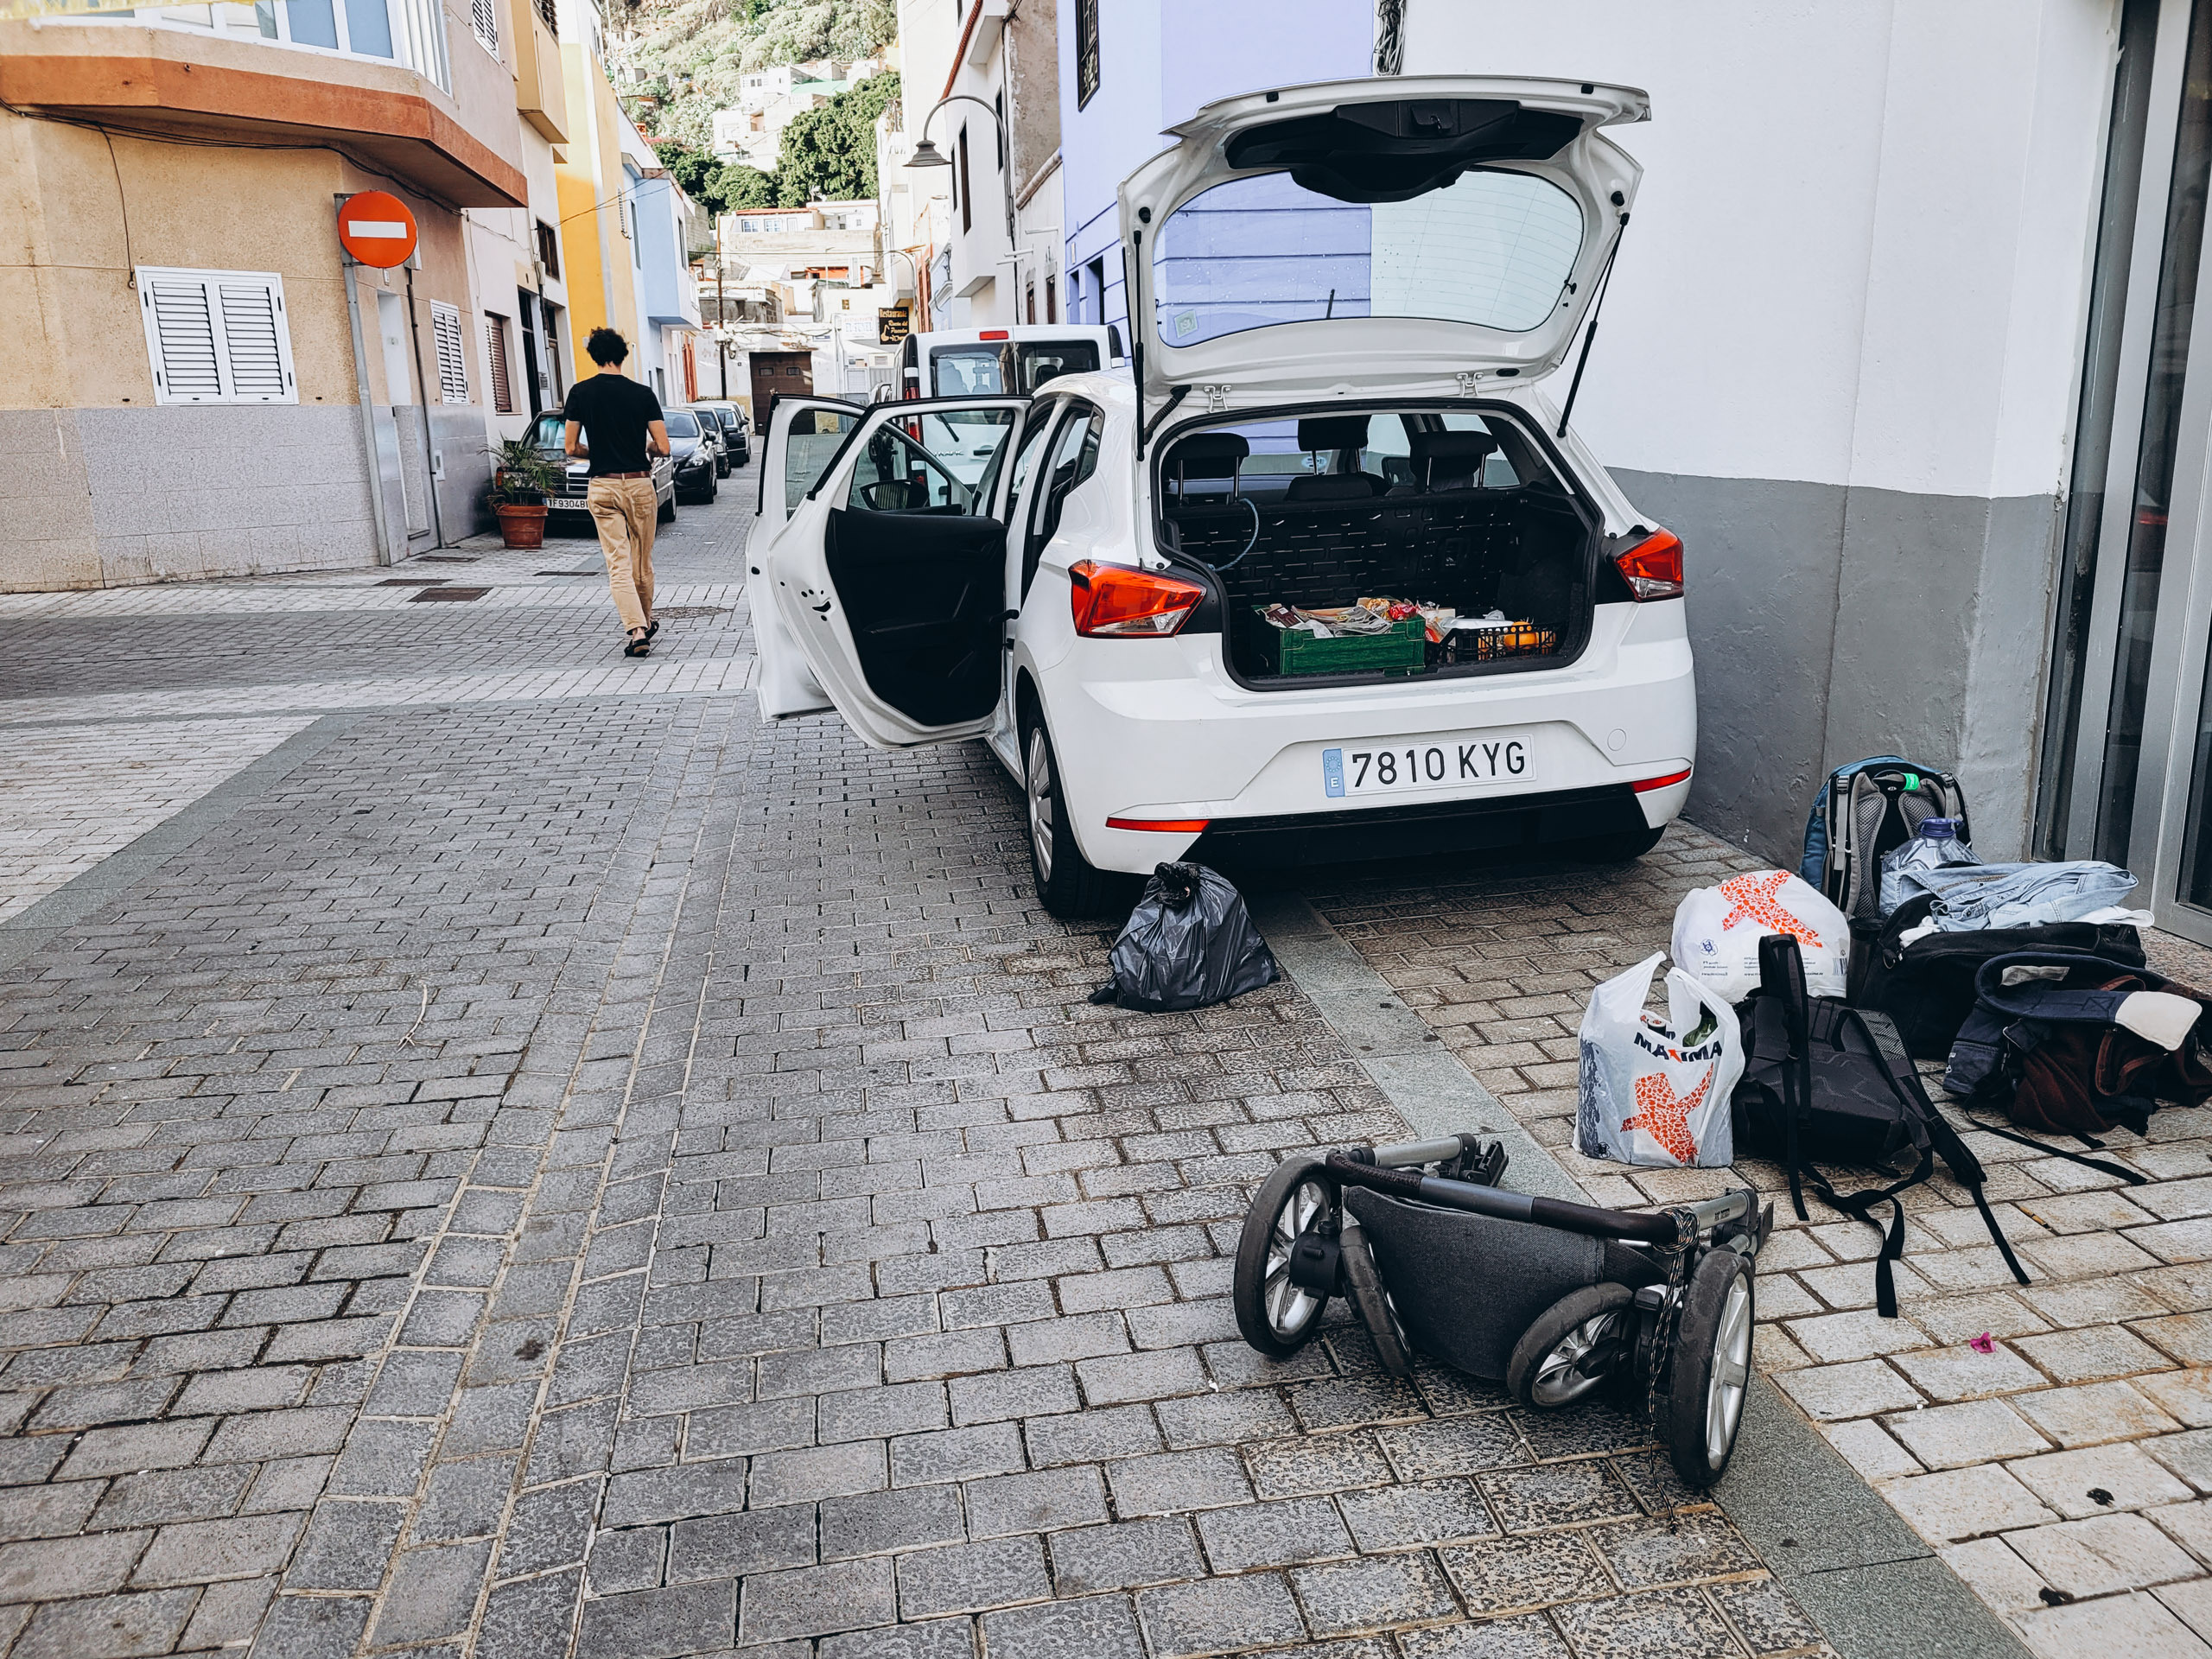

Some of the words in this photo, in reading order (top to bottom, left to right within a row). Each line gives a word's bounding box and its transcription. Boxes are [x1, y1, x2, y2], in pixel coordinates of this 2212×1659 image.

[1351, 747, 1446, 788] 7810
[1459, 741, 1525, 779] KYG
[1330, 777, 1339, 788] E
